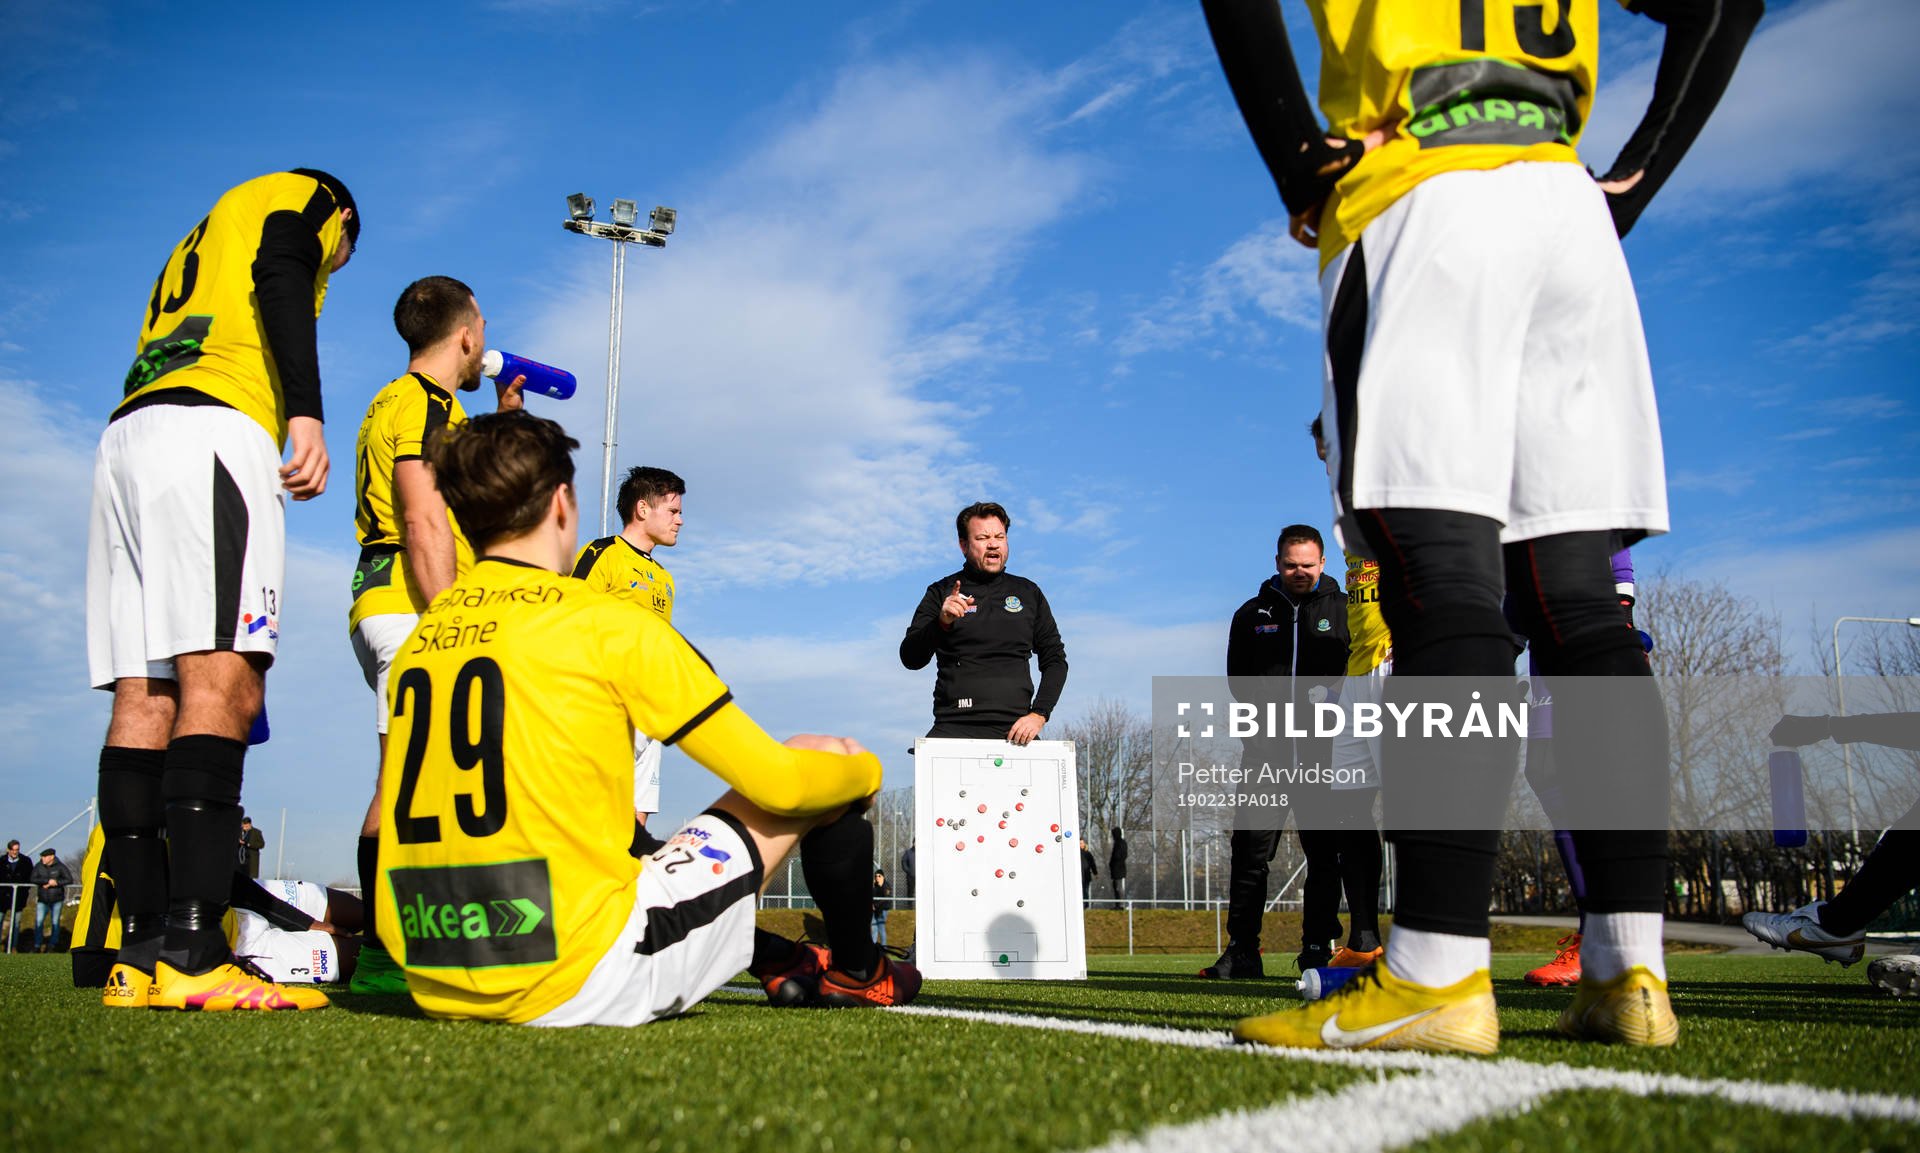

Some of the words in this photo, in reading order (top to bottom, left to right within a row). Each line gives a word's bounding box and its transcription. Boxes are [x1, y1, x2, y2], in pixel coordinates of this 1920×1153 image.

[262, 586, 276, 616] 13
[652, 594, 666, 610] LKF
[411, 616, 497, 654] Skåne
[393, 656, 507, 845] 29
[402, 898, 489, 939] akea
[312, 949, 321, 976] INTER
[320, 949, 329, 975] SPORT
